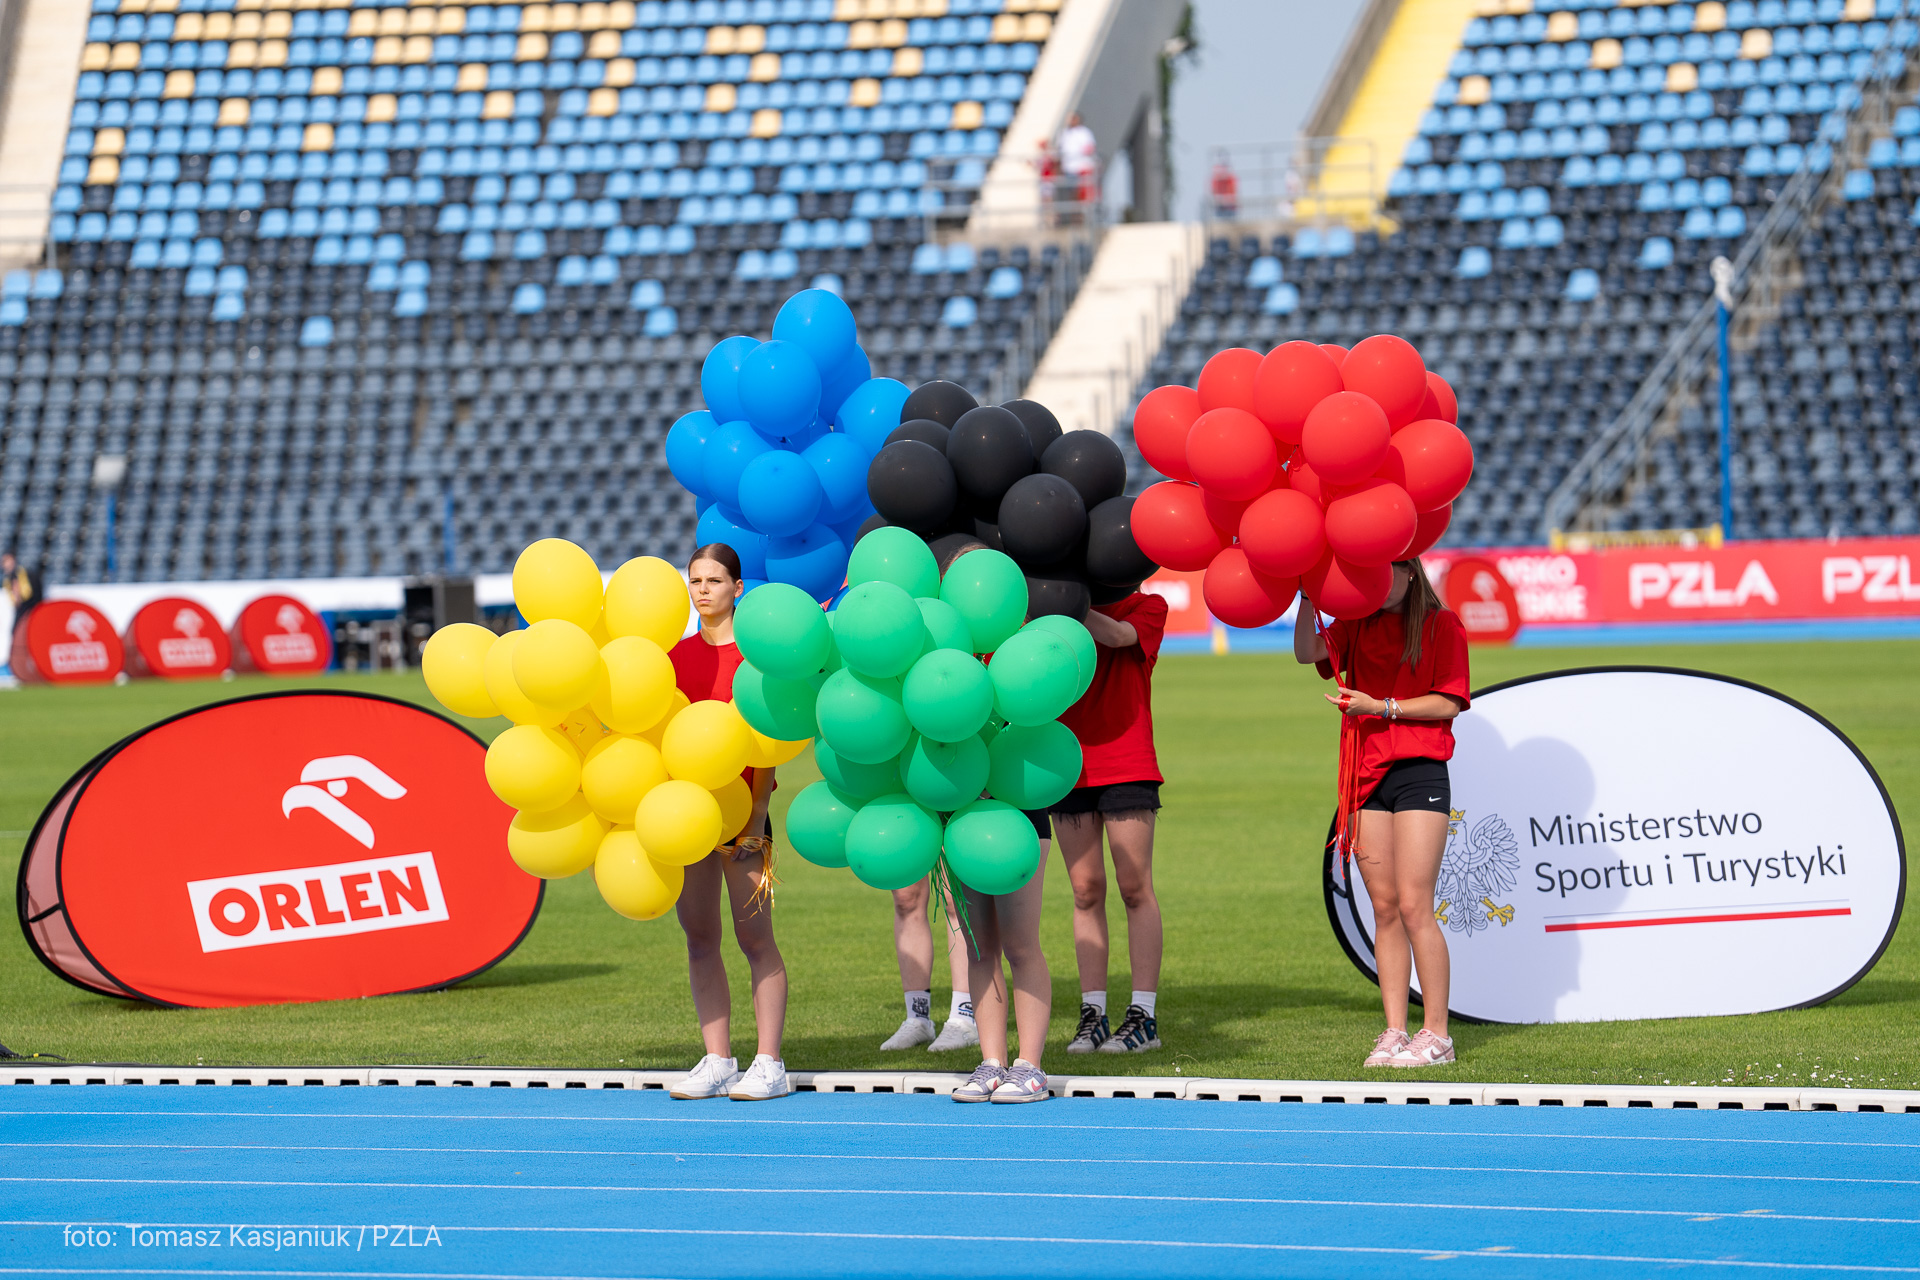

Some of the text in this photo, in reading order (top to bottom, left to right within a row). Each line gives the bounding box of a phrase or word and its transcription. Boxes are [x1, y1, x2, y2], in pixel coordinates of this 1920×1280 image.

[1629, 560, 1779, 609] PZLA
[1529, 809, 1763, 848] Ministerstwo
[1533, 844, 1847, 898] Sportu i Turystyki
[209, 866, 429, 937] ORLEN
